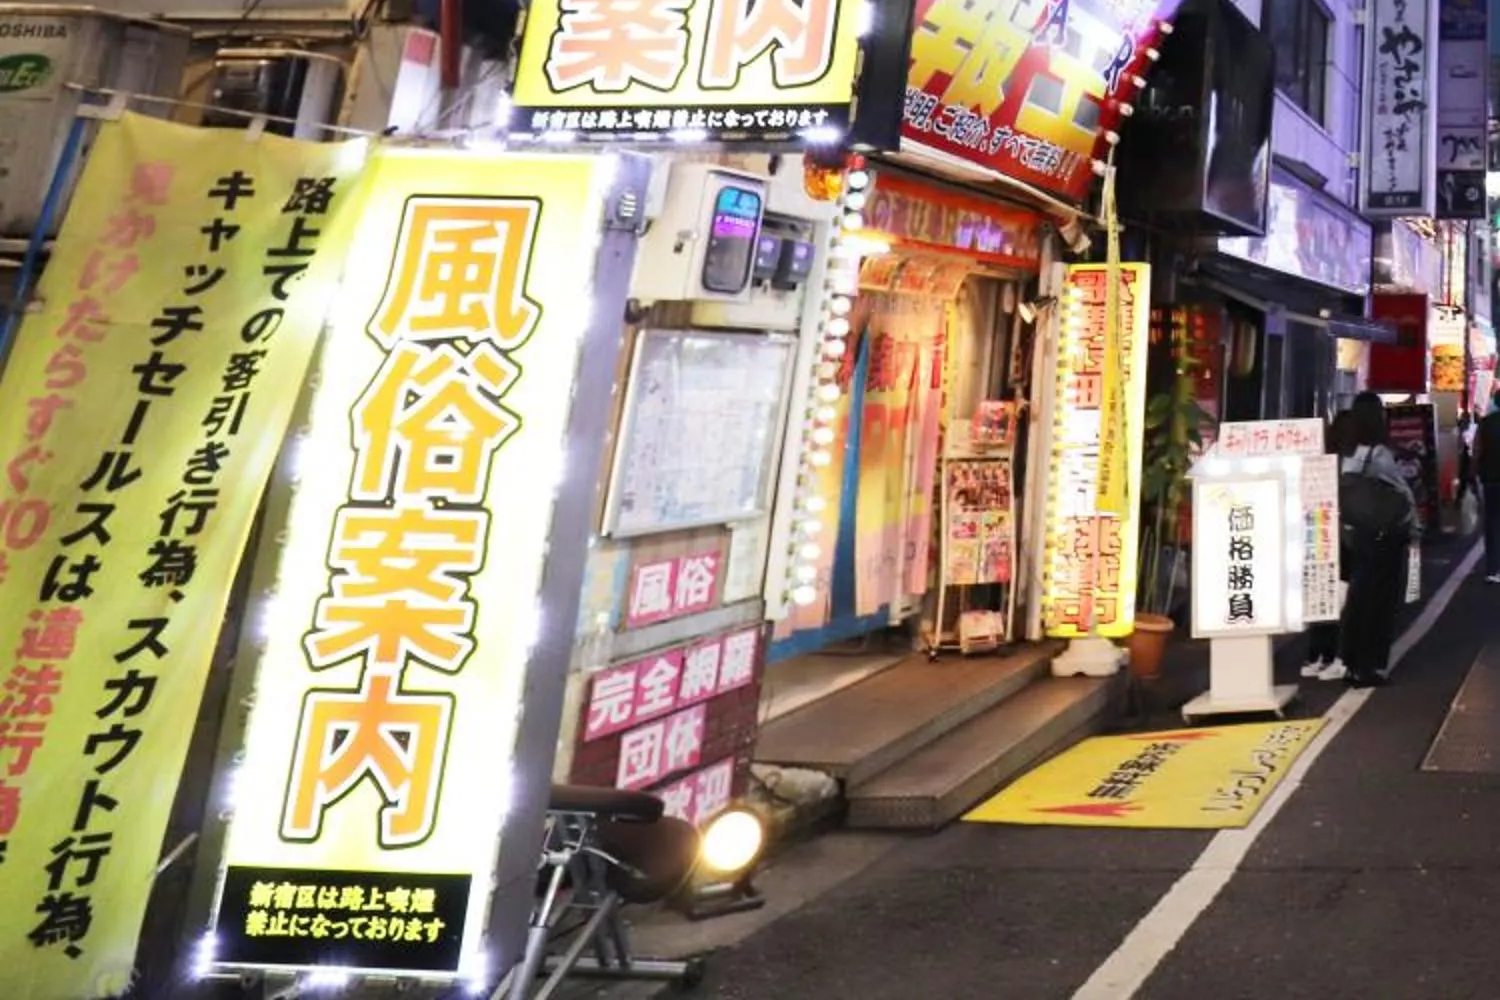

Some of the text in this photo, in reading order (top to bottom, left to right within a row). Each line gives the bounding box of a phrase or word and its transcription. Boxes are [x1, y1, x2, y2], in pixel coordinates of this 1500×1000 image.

[0, 22, 68, 39] OSHIBA
[278, 193, 545, 851] 風俗案内
[632, 556, 715, 616] 風俗
[588, 630, 756, 733] 完全網羅
